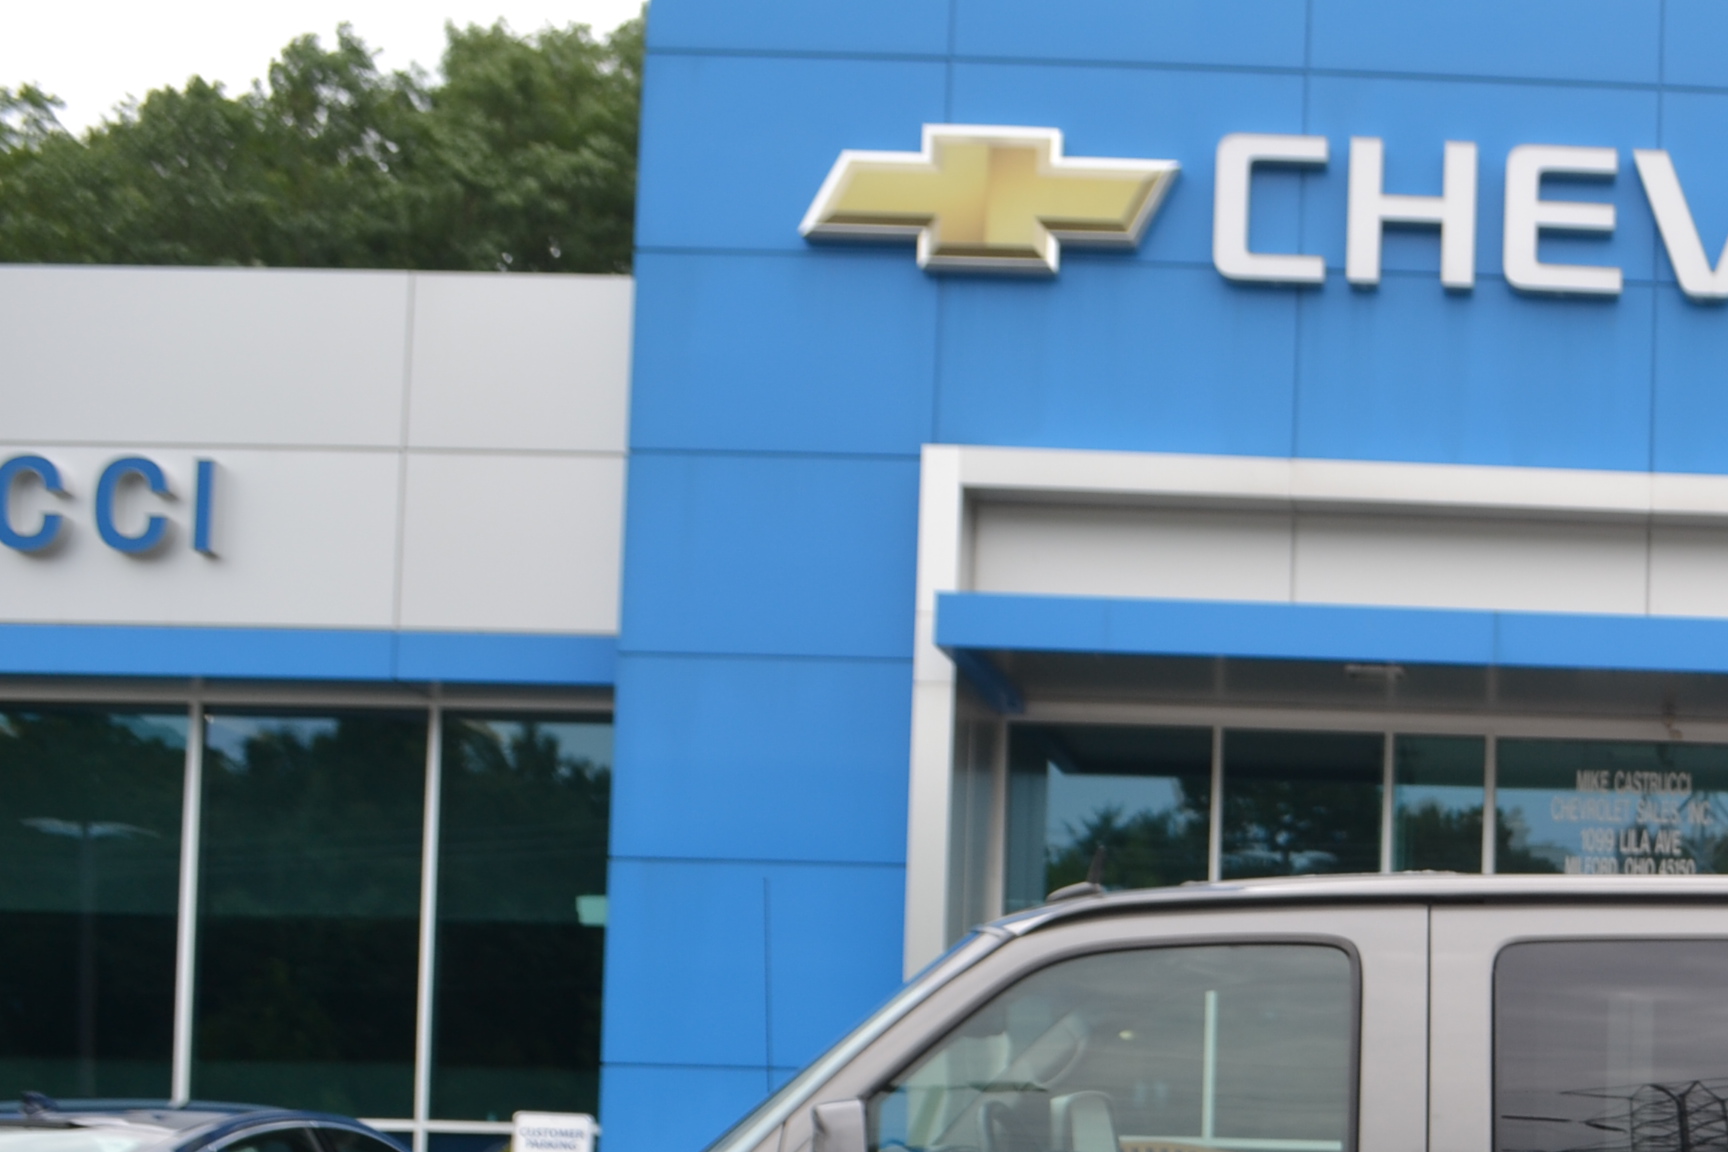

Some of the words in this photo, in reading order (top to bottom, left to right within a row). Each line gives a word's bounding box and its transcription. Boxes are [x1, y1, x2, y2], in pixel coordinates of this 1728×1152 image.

[0, 455, 214, 554] CCI
[1576, 769, 1610, 792] MIKE
[1614, 771, 1693, 795] CASTRUCCI
[1551, 796, 1631, 822] CHEVROLET
[1581, 828, 1614, 852] 1099
[1619, 829, 1651, 854] LILA
[1654, 830, 1682, 856] AVE
[519, 1126, 585, 1139] CUSTOMER
[525, 1138, 578, 1151] PARKING
